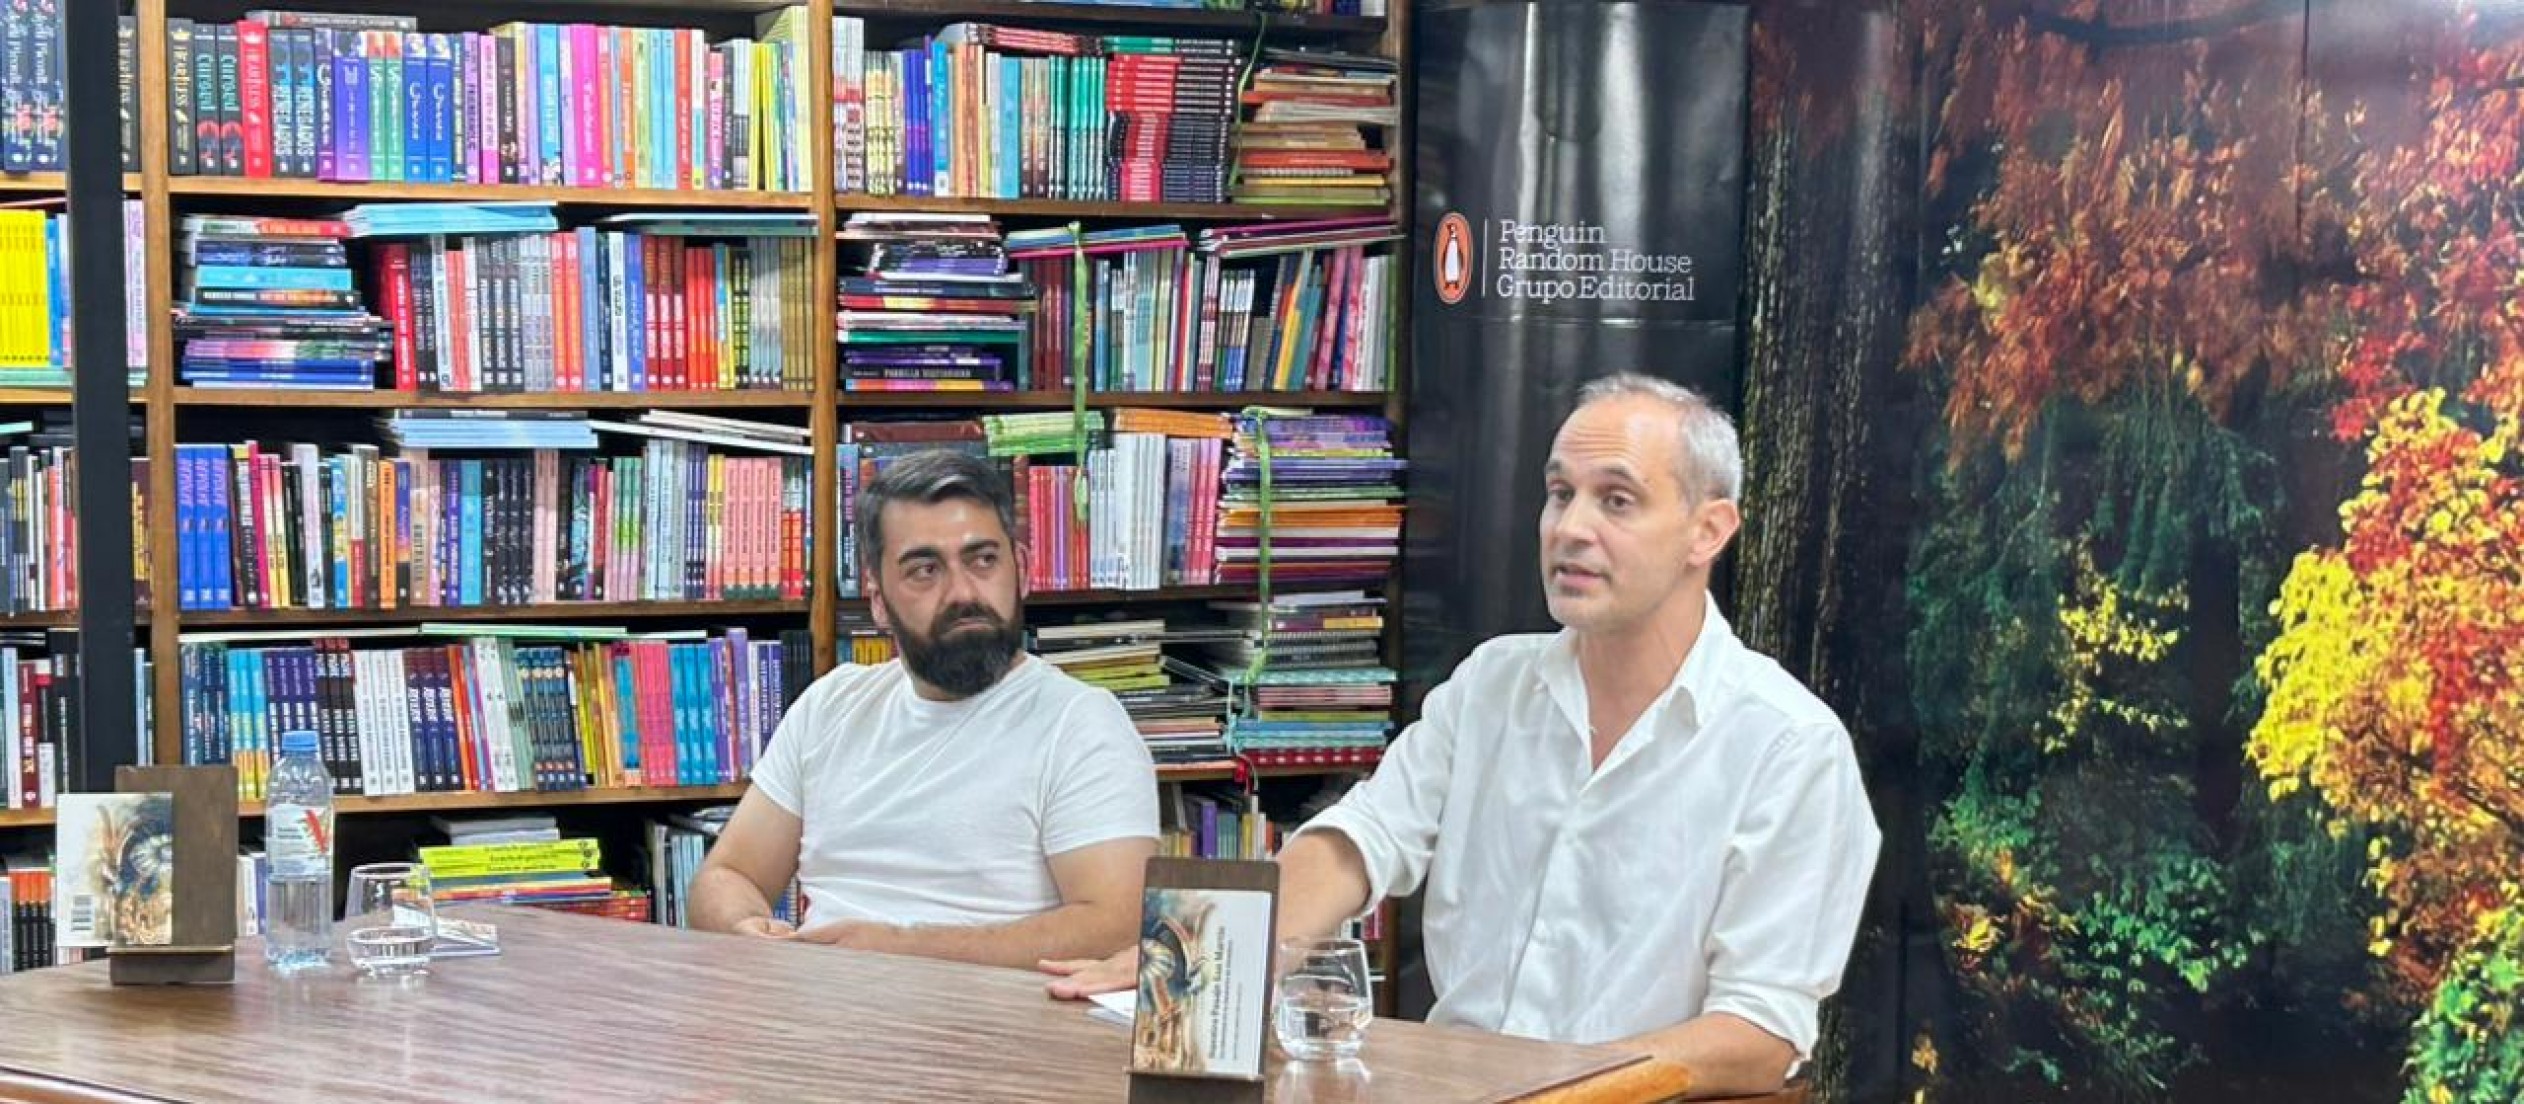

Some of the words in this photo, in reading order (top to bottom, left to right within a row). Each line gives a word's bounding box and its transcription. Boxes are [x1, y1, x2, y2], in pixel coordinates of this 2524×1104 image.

[221, 53, 240, 112] Cursed
[296, 84, 315, 156] RENEGADOS
[1499, 219, 1605, 250] Penguin
[1497, 248, 1604, 271] Random
[1609, 248, 1693, 274] House
[1496, 274, 1576, 304] Grupo
[1577, 276, 1695, 301] Editorial
